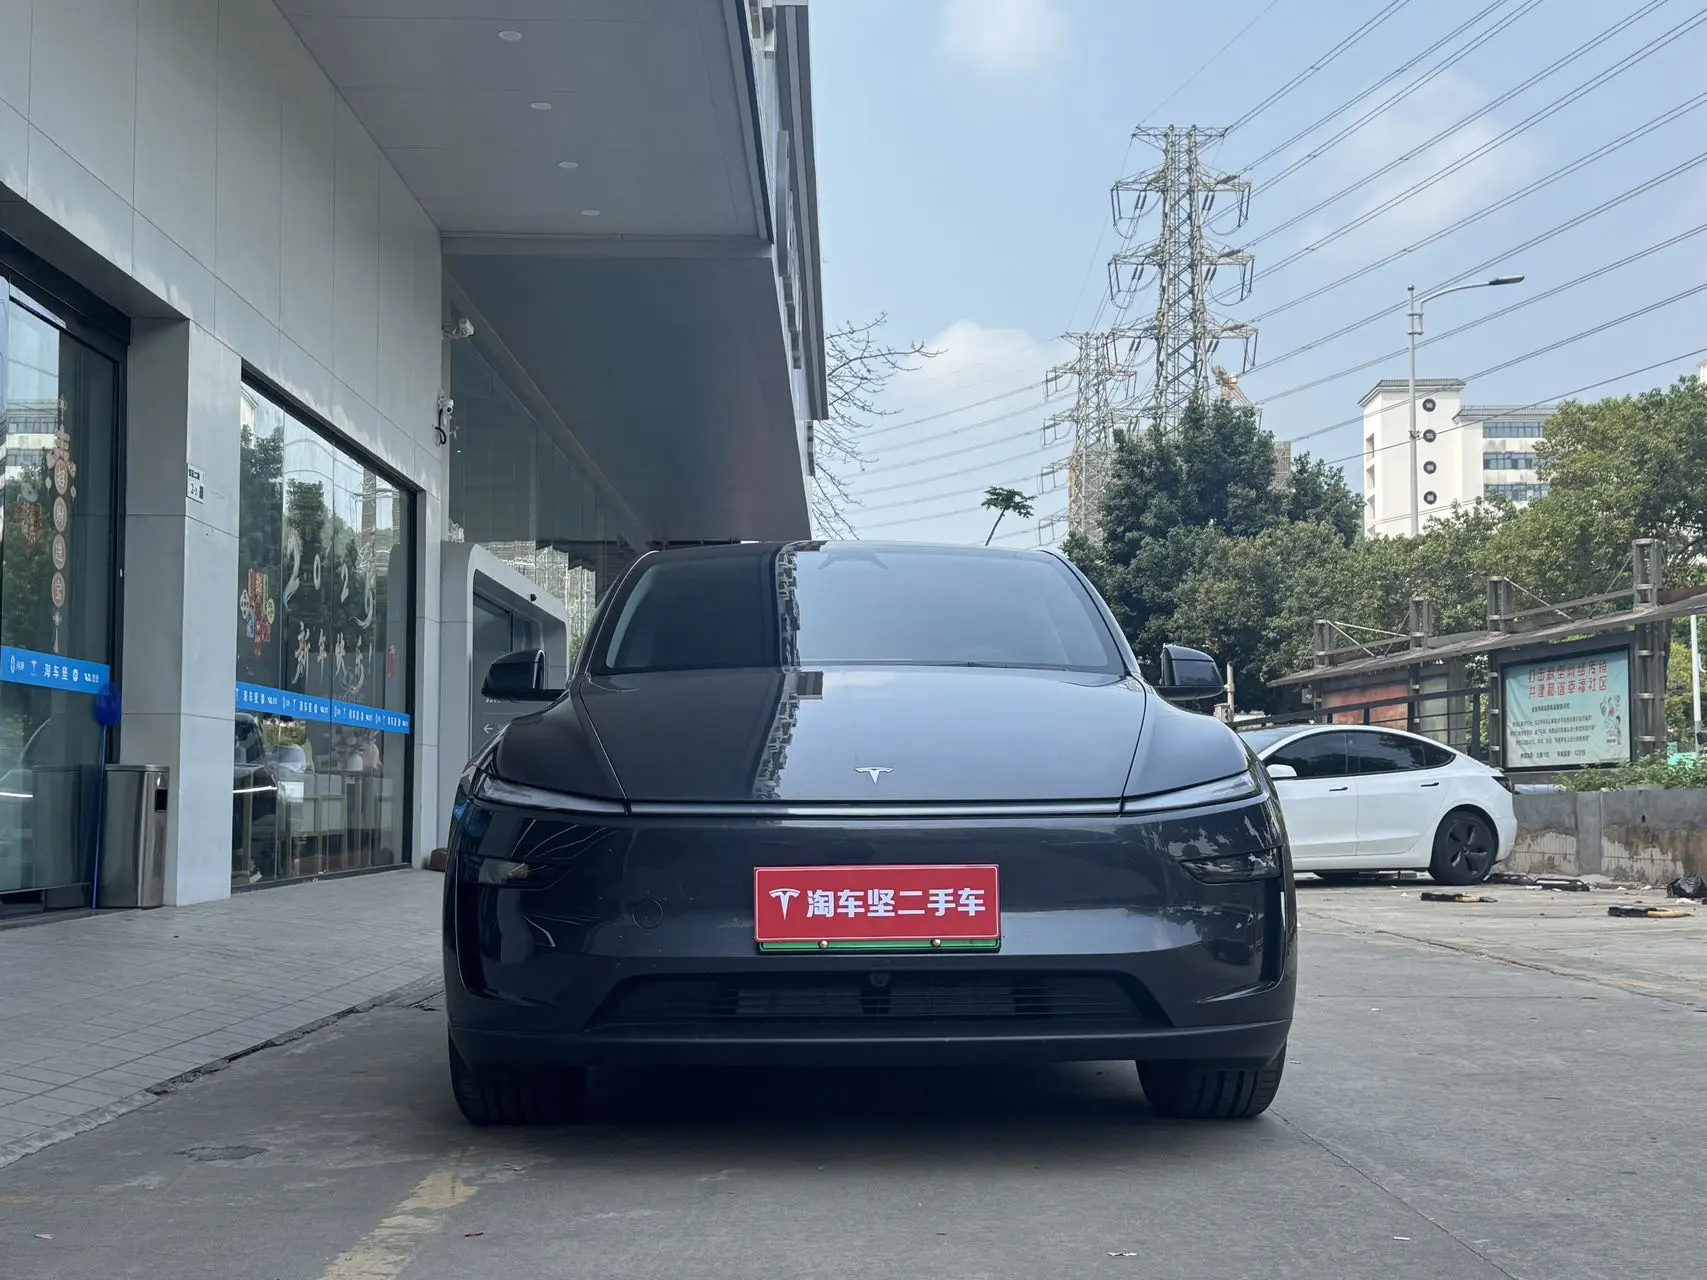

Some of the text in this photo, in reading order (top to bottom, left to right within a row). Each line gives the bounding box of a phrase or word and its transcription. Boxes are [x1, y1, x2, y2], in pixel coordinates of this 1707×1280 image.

[806, 888, 986, 918] 淘车坚二手车
